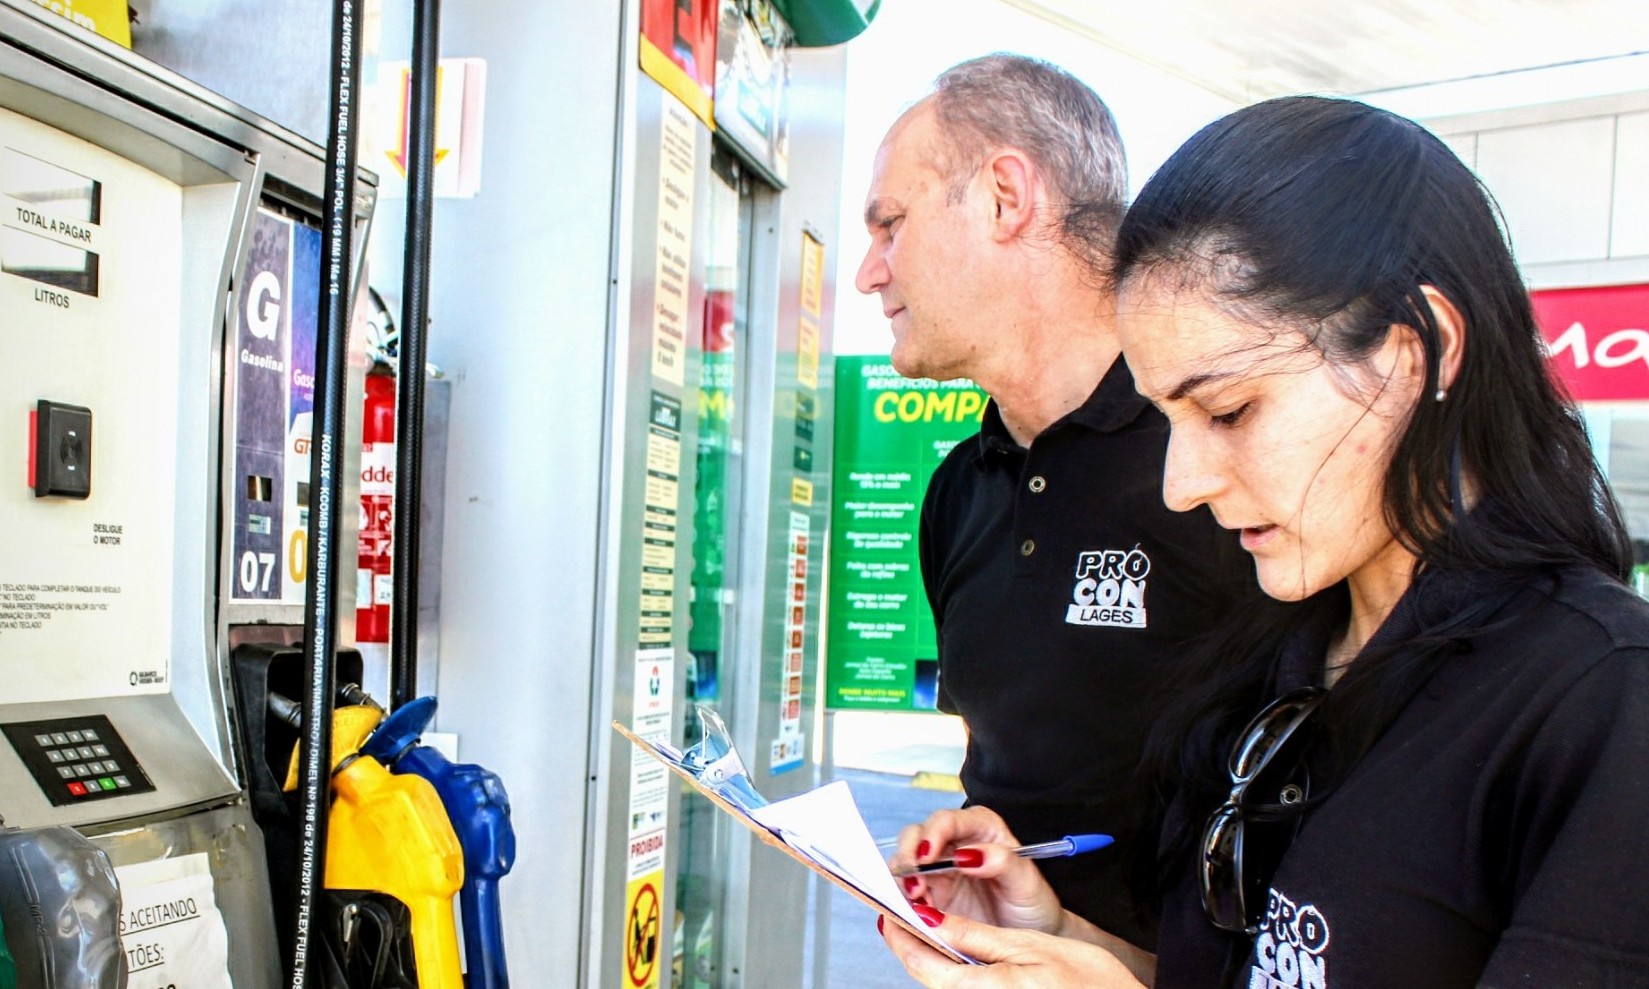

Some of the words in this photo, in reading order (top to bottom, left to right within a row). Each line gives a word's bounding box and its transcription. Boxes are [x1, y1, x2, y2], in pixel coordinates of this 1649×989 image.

[341, 15, 353, 69] 24/10/2012
[339, 76, 350, 104] FLEX
[337, 105, 349, 134] FUEL
[335, 135, 347, 166] HOSE
[333, 190, 344, 213] POL
[16, 207, 48, 230] TOTAL
[50, 219, 57, 232] A
[59, 221, 91, 243] PAGAR
[35, 287, 70, 309] LITROS
[246, 270, 281, 342] G
[241, 348, 284, 373] Gasolina
[293, 369, 315, 388] Gaso
[320, 434, 332, 479] KORAX
[318, 486, 329, 528] KCOMB
[93, 523, 123, 534] DESLIGUE
[93, 535, 98, 544] O
[100, 535, 121, 545] MOTOR
[240, 550, 276, 593] 07
[288, 529, 307, 584] 0
[2, 583, 26, 592] TECLADO
[27, 584, 40, 592] PARA
[40, 584, 70, 593] COMPLETAR
[315, 537, 328, 616] KARBURANTE
[12, 593, 36, 601] TECLADO
[1073, 577, 1146, 608] CON
[19, 621, 42, 629] TECLADO
[33, 612, 51, 620] LITROS
[1080, 608, 1133, 624] LAGES
[313, 628, 325, 686] PORTARIA
[308, 749, 319, 782] DIMEL
[305, 803, 315, 821] 198
[304, 823, 314, 838] de
[301, 840, 313, 896] 24/10/2012
[130, 897, 197, 929] ACEITANDO
[298, 905, 310, 934] FLEX
[295, 936, 307, 966] FUEL
[1256, 931, 1326, 989] CON
